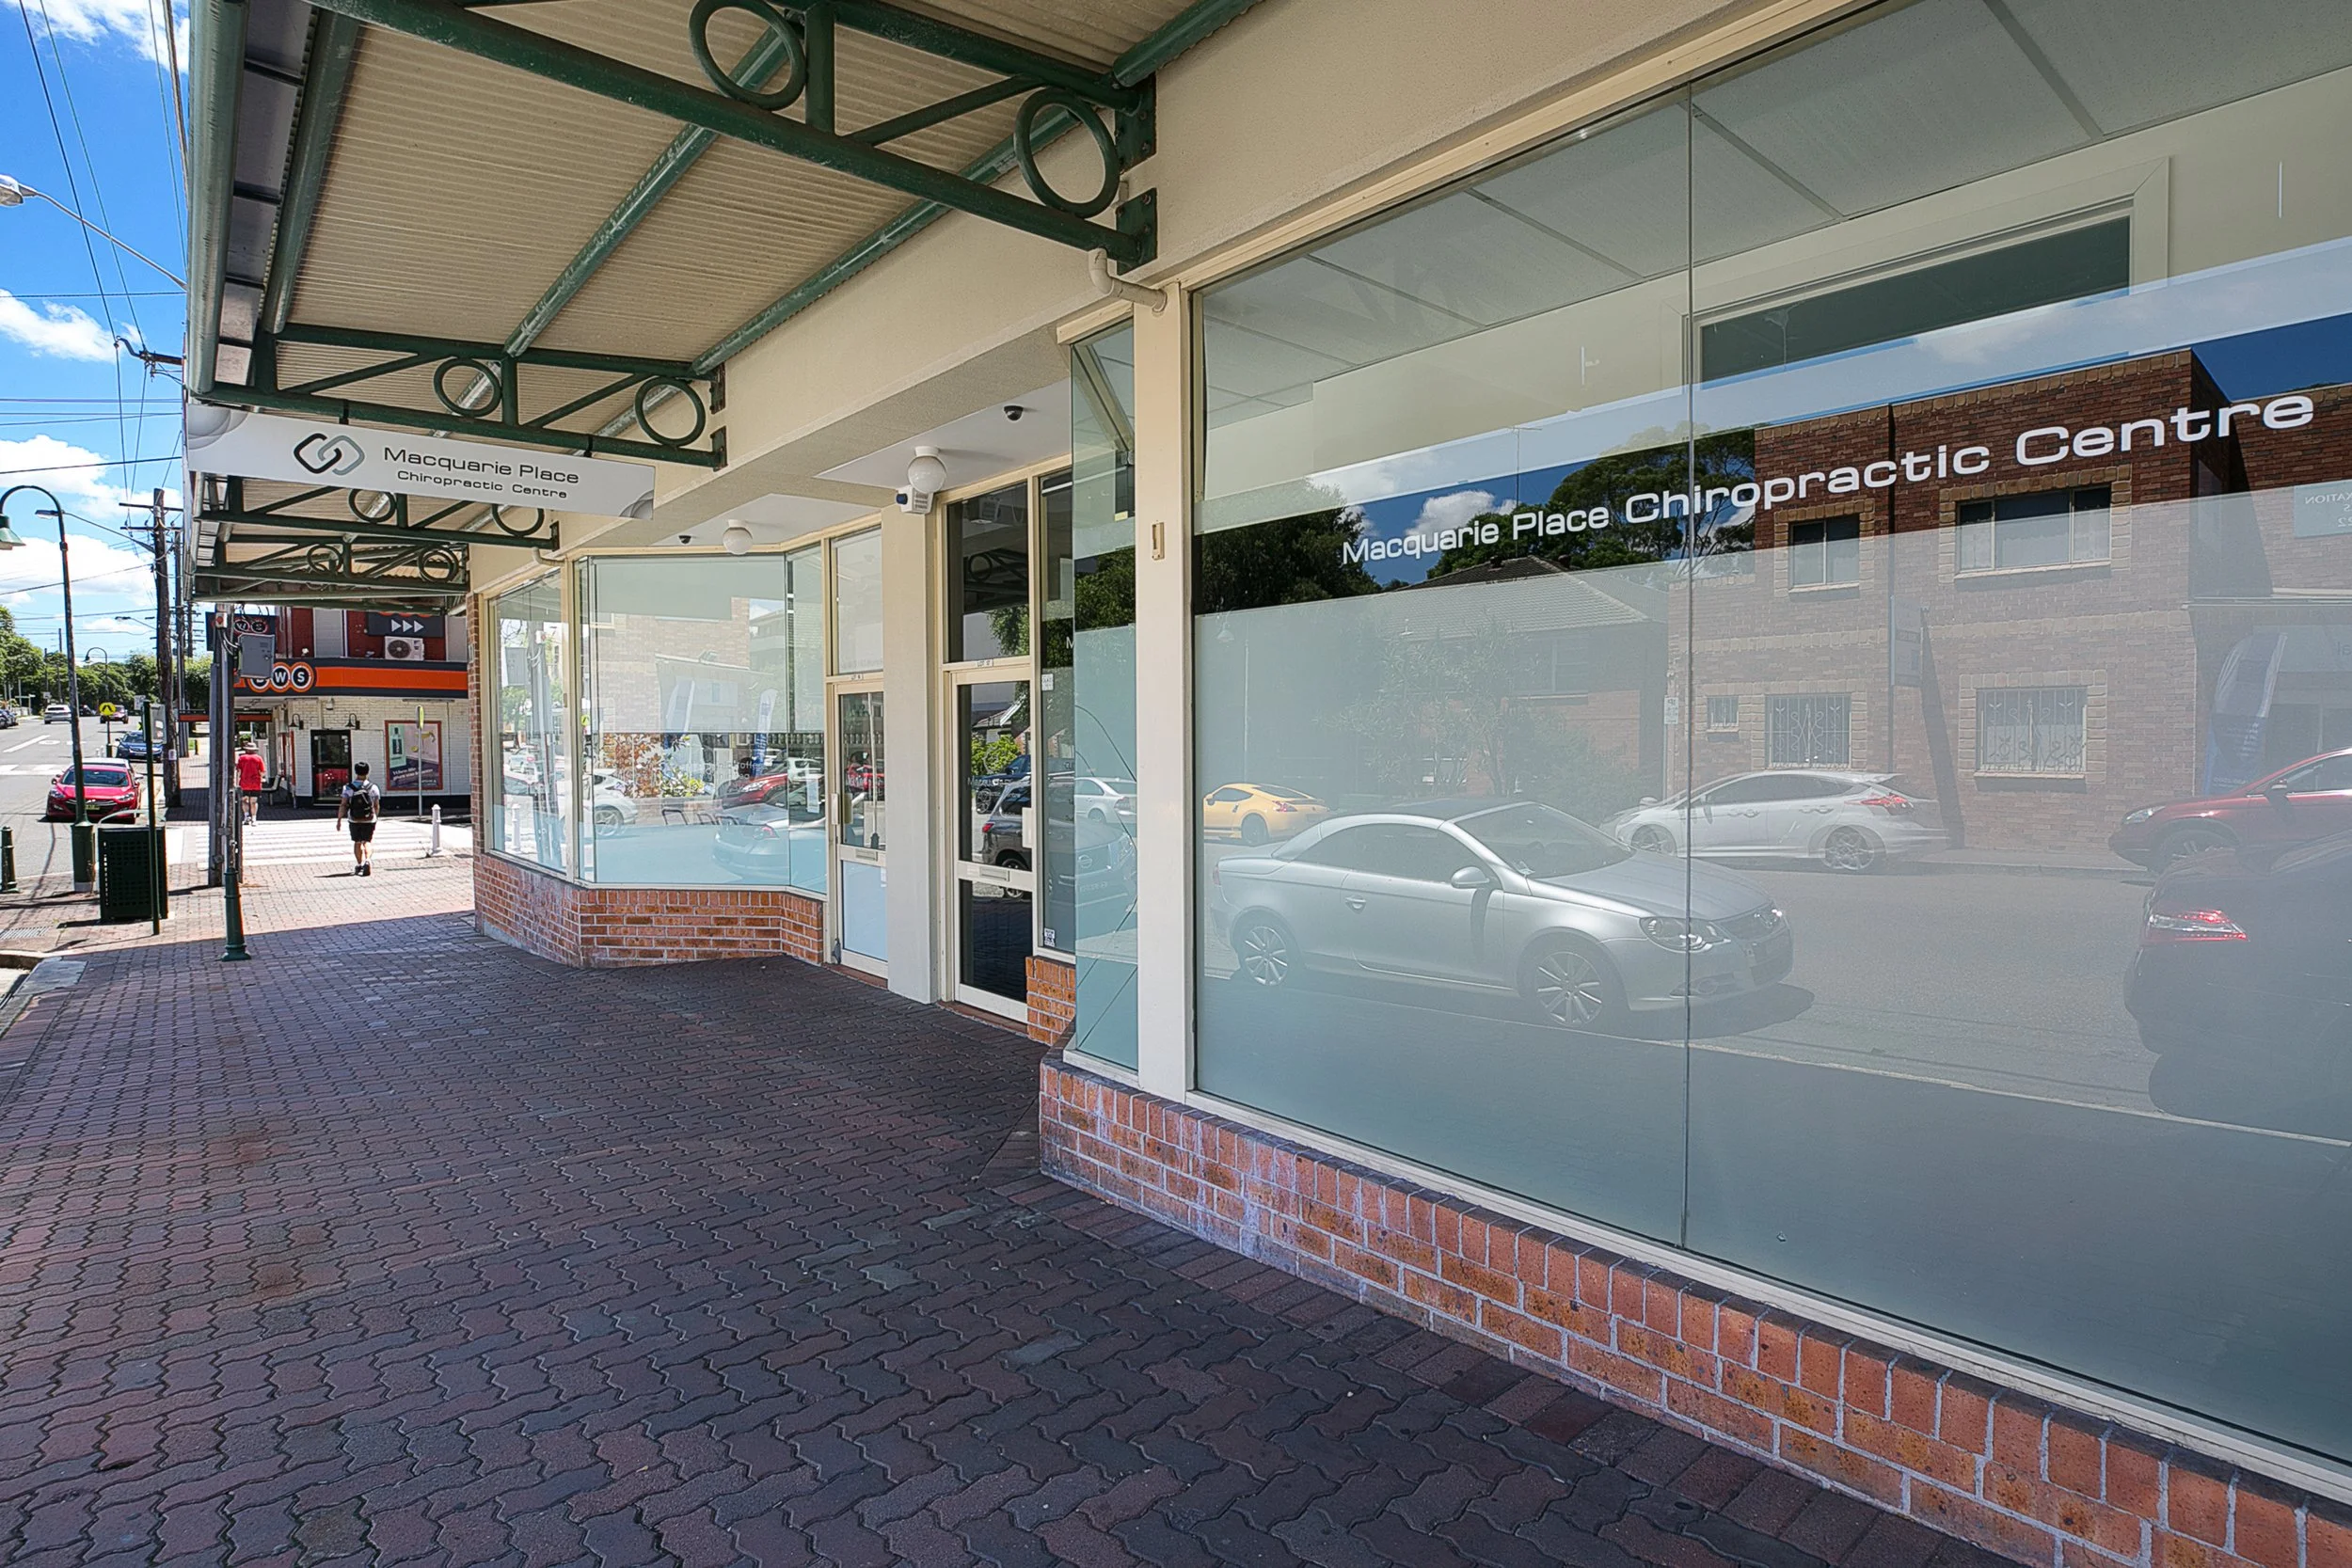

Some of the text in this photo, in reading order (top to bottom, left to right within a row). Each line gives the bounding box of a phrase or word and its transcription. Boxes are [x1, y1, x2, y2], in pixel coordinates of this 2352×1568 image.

[384, 447, 580, 483] Macquarie Place
[1343, 395, 2314, 564] Macquarie Place Chiropractic Centre
[397, 470, 567, 499] Chiropractic Centre
